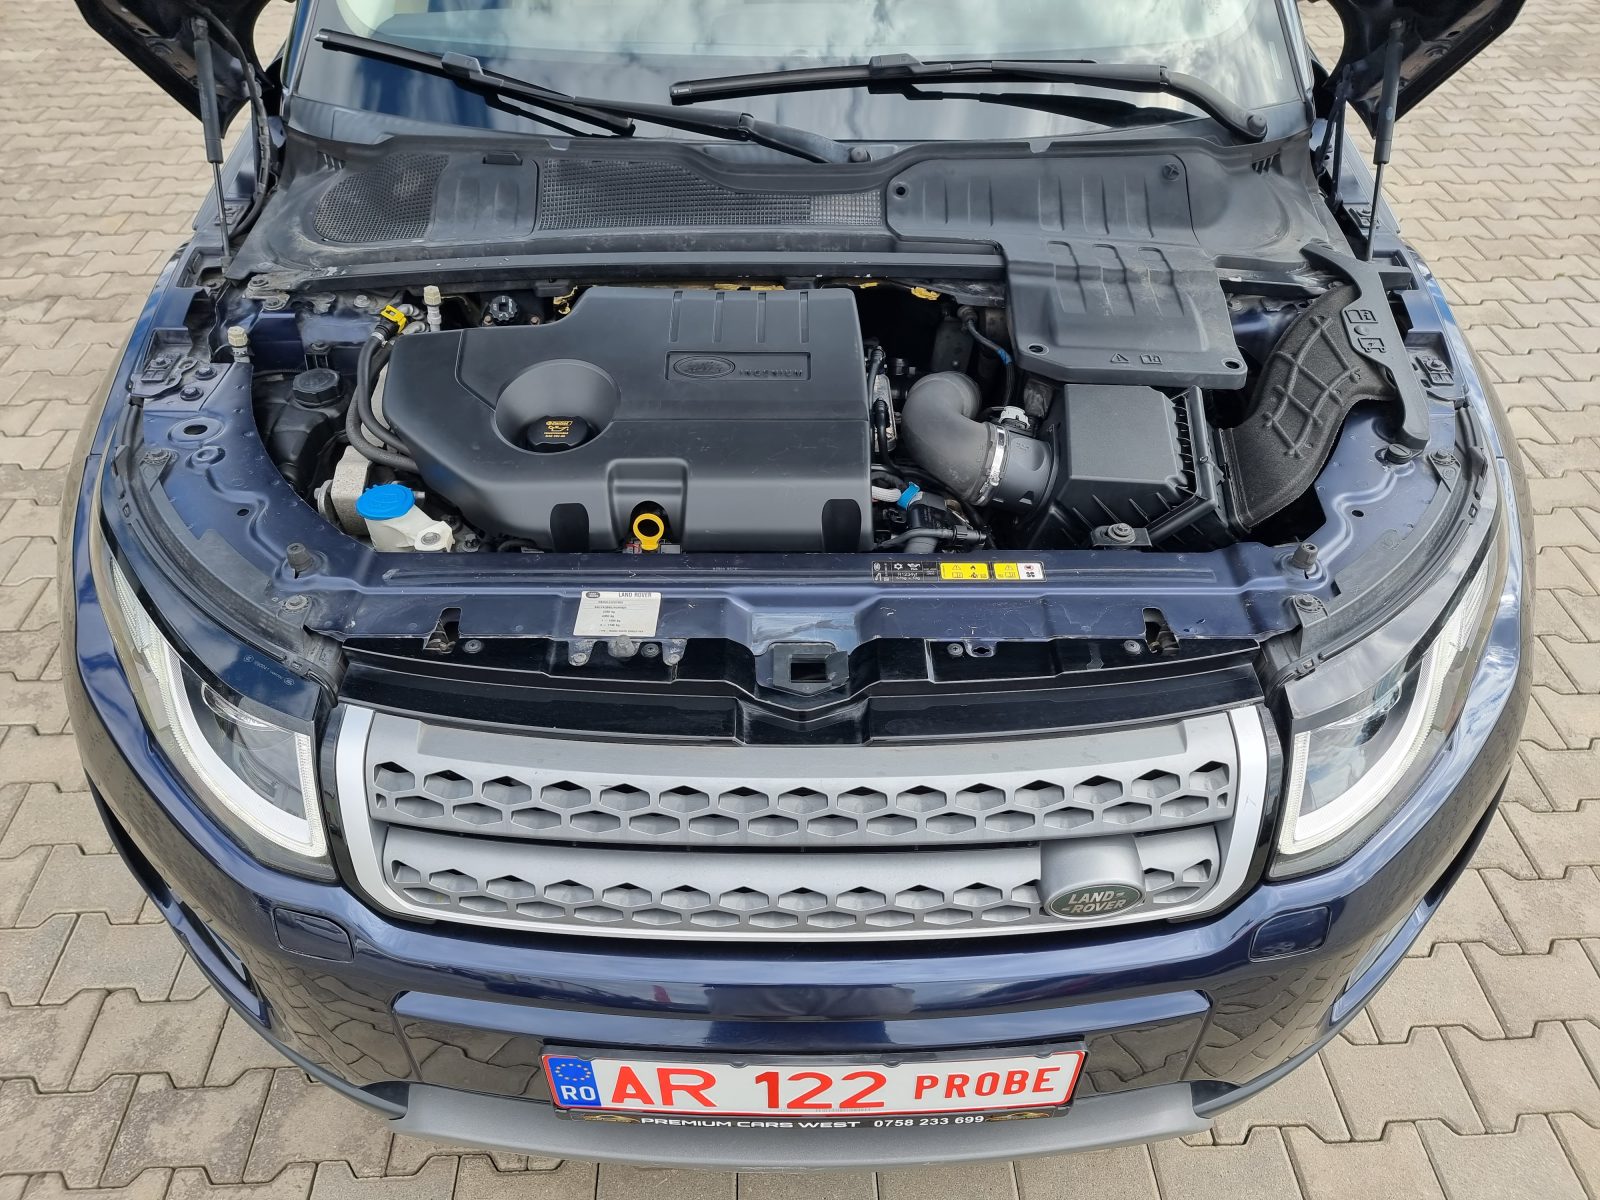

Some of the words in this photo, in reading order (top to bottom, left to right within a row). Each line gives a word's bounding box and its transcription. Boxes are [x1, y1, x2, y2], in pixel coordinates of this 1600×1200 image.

[1068, 891, 1115, 904] LAND
[1070, 899, 1127, 913] ROVER
[560, 1085, 596, 1101] RO
[611, 1065, 718, 1107] AR
[755, 1070, 887, 1109] 122
[914, 1066, 1061, 1100] PROBE
[641, 1118, 732, 1128] PREMIUM
[737, 1121, 794, 1129] CARS
[797, 1121, 861, 1129] WEST
[874, 1118, 914, 1128] 0758
[919, 1117, 950, 1126] 233
[954, 1115, 985, 1125] 699
